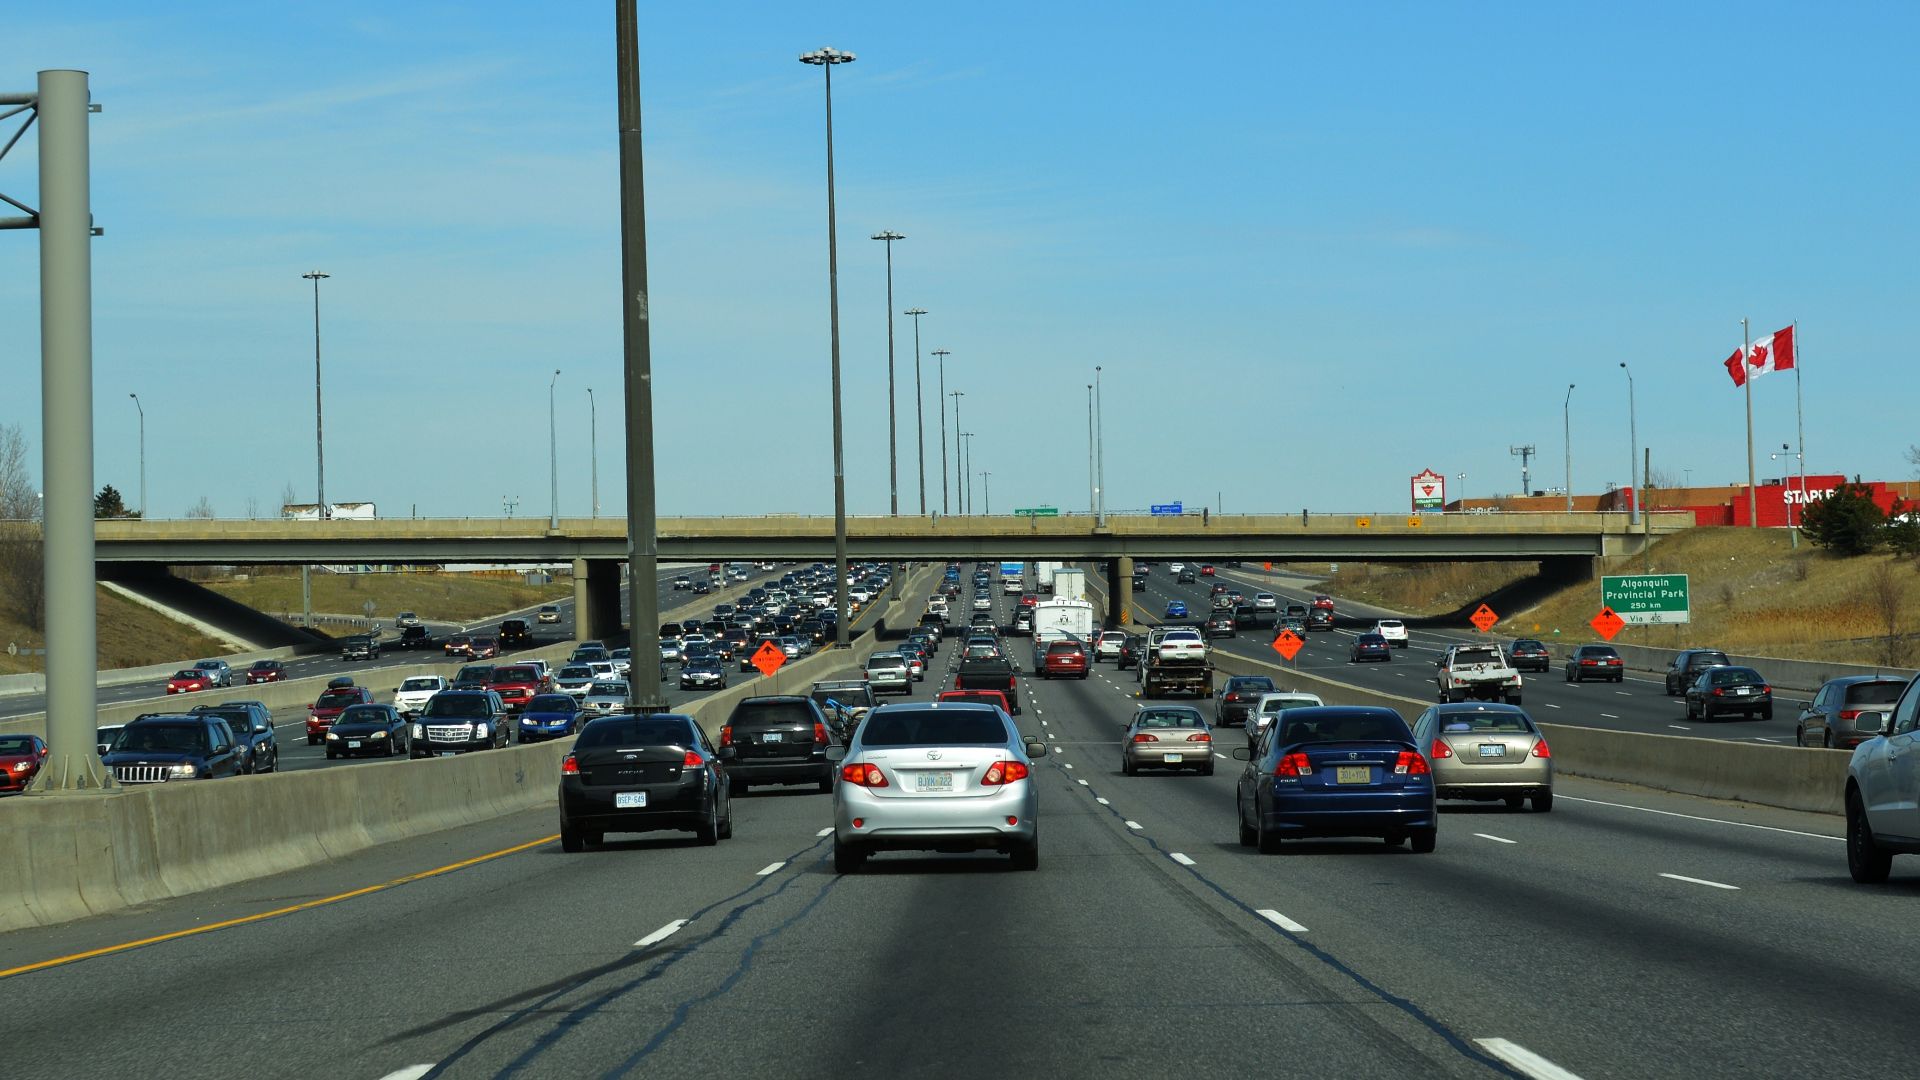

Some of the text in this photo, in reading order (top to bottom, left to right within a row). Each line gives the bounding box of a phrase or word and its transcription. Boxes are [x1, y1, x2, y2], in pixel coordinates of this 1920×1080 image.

[1783, 488, 1839, 505] STAPLE
[1621, 578, 1669, 590] Algonquin
[1606, 589, 1684, 600] Provincial Park
